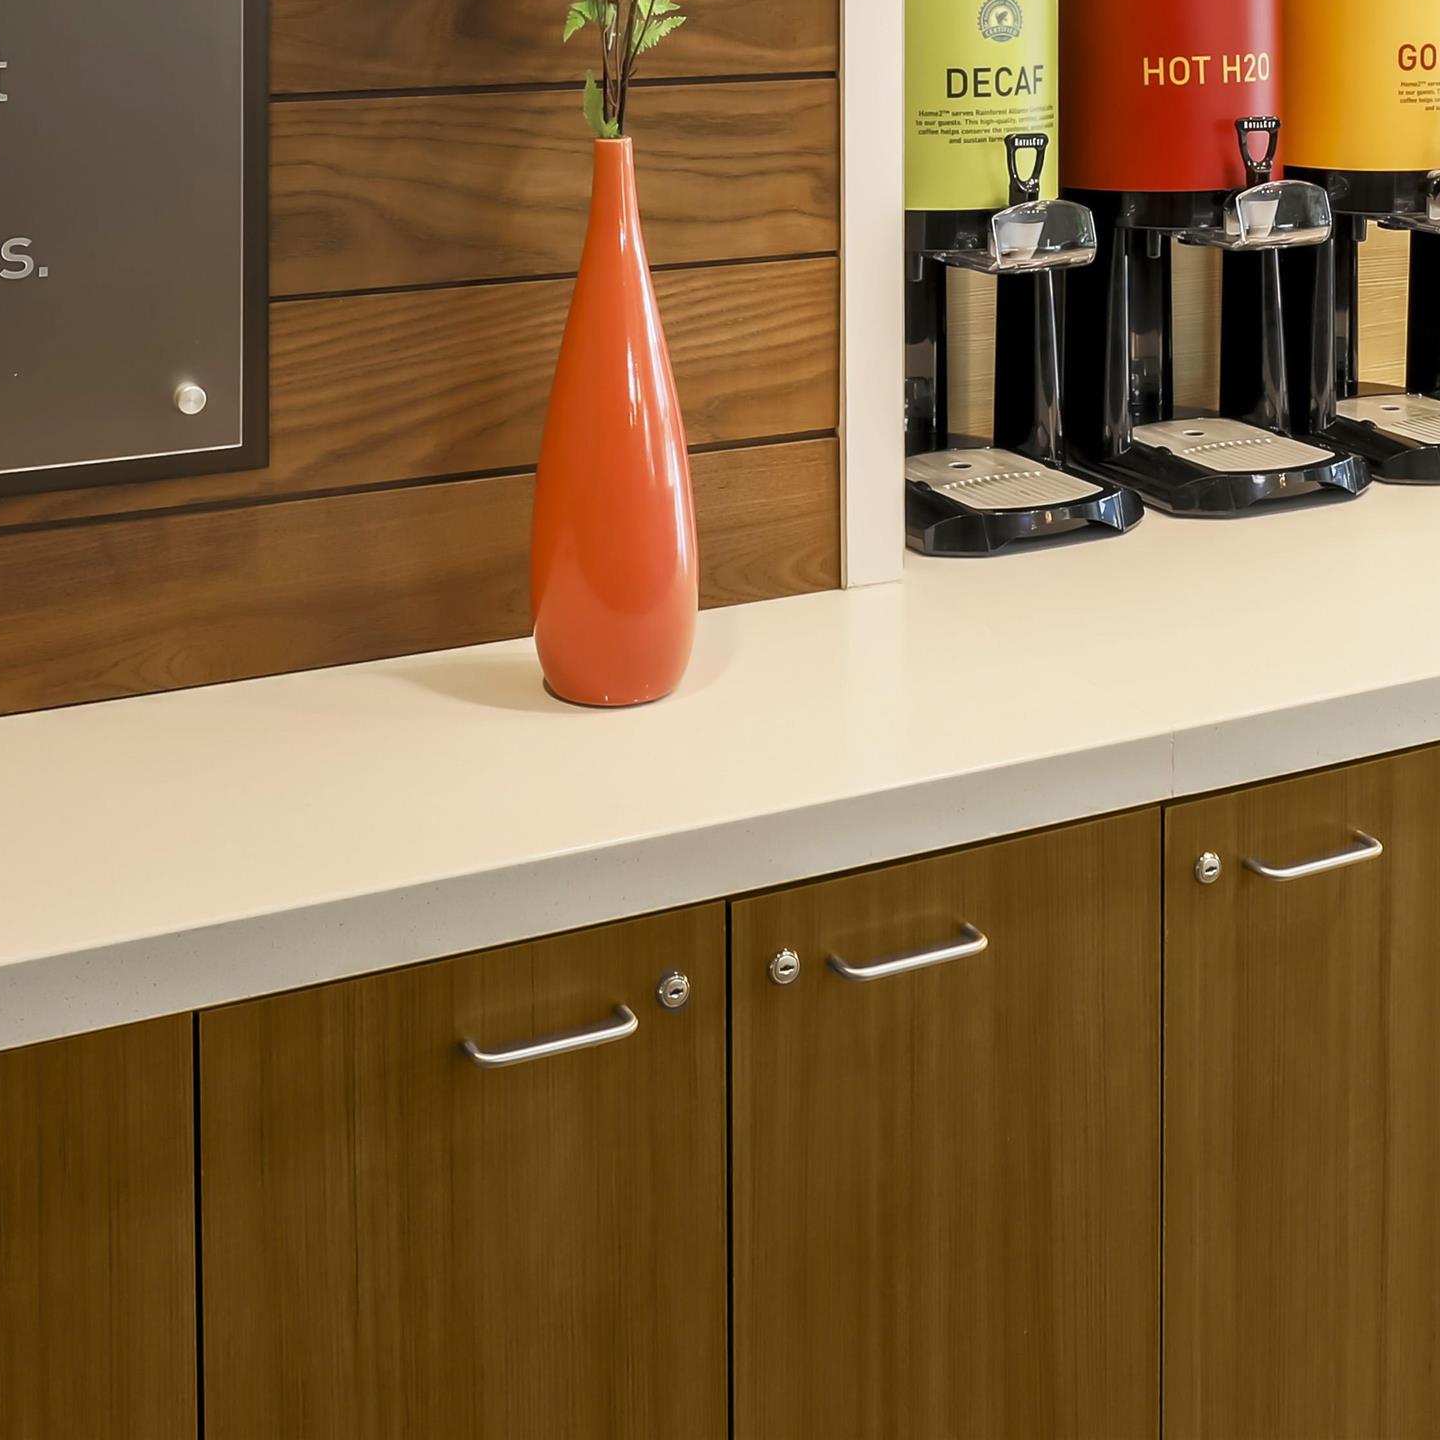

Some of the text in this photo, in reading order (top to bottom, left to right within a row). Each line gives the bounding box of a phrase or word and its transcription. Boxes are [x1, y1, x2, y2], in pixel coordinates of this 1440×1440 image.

[946, 64, 1044, 99] DECAF
[1143, 55, 1212, 86] HOT
[918, 127, 939, 135] coffee
[940, 127, 960, 137] helps
